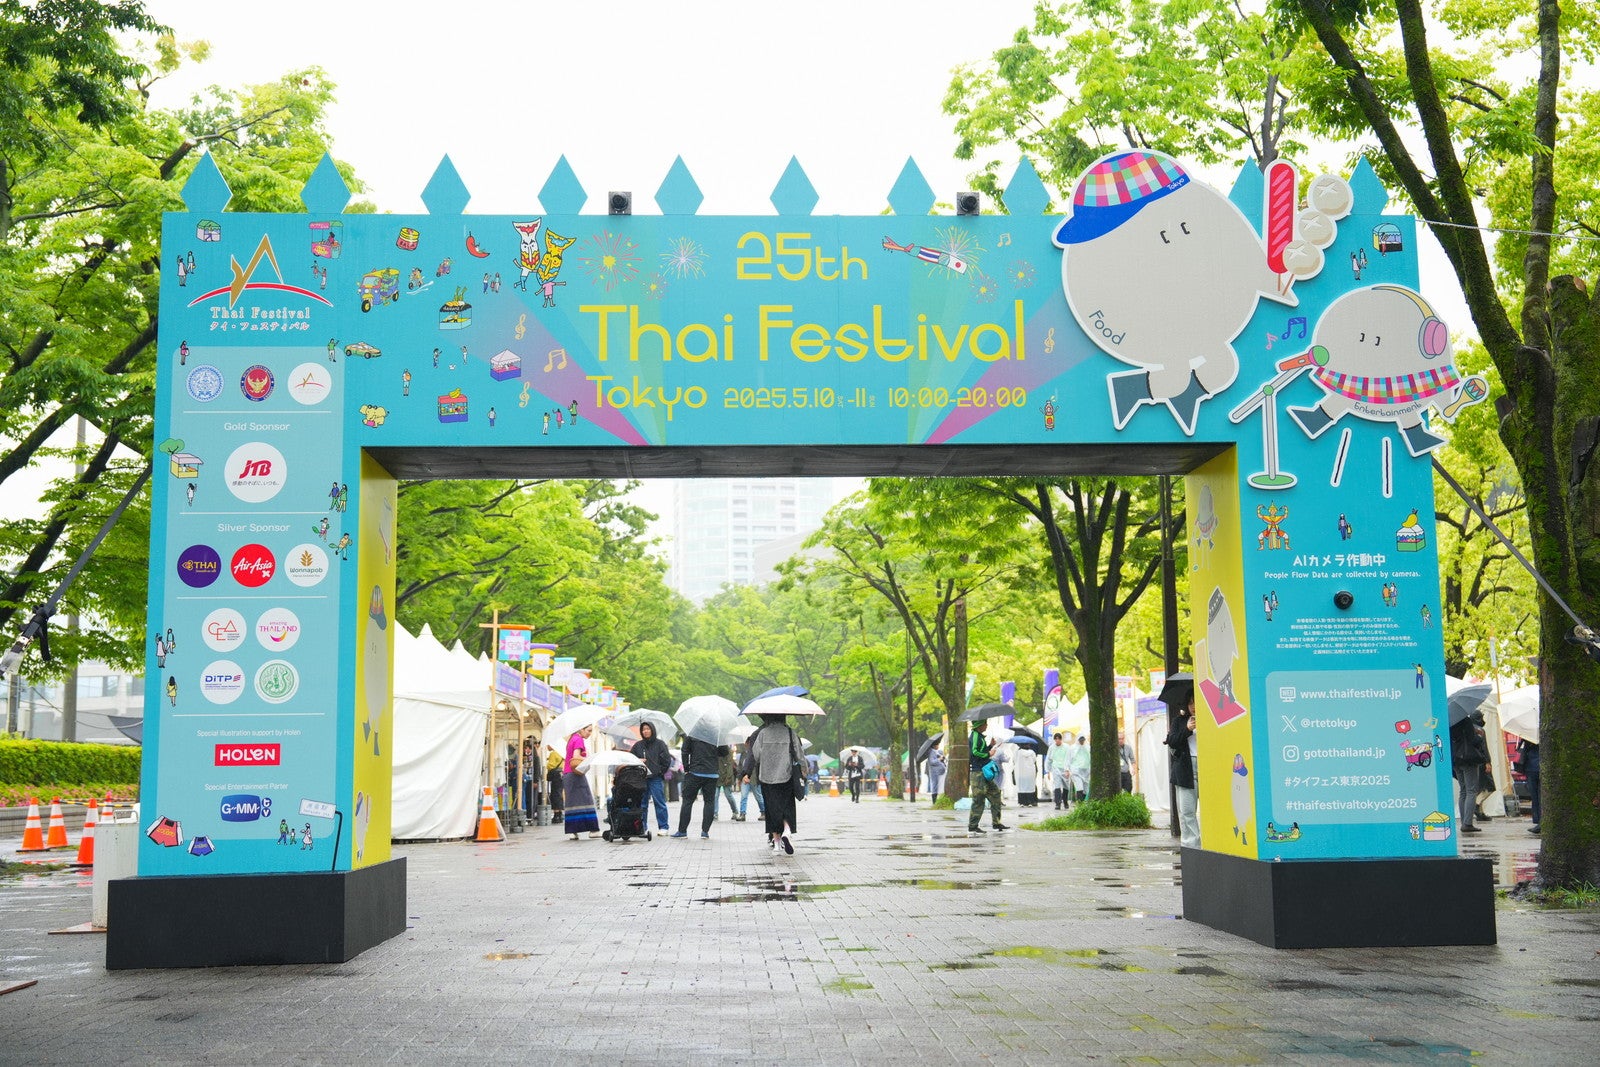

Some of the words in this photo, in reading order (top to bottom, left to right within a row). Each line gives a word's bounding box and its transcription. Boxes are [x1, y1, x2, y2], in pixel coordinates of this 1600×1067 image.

[1166, 177, 1185, 191] Tokyo
[736, 231, 868, 281] 25th
[210, 307, 245, 319] Thai
[251, 307, 310, 319] Festival
[210, 321, 310, 332] タイ・フェスティバル
[579, 304, 734, 362] Thai
[759, 299, 1025, 362] Festival
[1089, 310, 1126, 345] Food
[586, 375, 707, 421] Tokyo
[723, 387, 835, 408] 2025.5.10
[889, 387, 1027, 408] 10:00-20:00
[1354, 402, 1422, 417] Entertainment
[224, 422, 247, 431] Gold
[249, 422, 290, 432] Sponsor
[239, 459, 272, 479] JTB
[217, 523, 247, 532] Silver
[249, 523, 290, 533] Sponsor
[193, 561, 217, 569] THAI
[1293, 553, 1386, 567] AIカメラ作動中
[1264, 571, 1288, 579] People
[1380, 571, 1389, 579] by
[1300, 689, 1402, 700] www.thaifestival.jp
[1301, 719, 1357, 730] @rtetokyo
[196, 729, 218, 738] Special
[252, 729, 274, 738] support
[275, 729, 283, 738] by
[283, 729, 301, 737] Holen
[1303, 747, 1386, 760] gotothailand.jp
[204, 783, 226, 791] Special
[227, 782, 268, 790] Entertainment
[1284, 775, 1390, 788] #タイフェス東京2025
[1286, 798, 1417, 813] #thaifestivaltokyo2025
